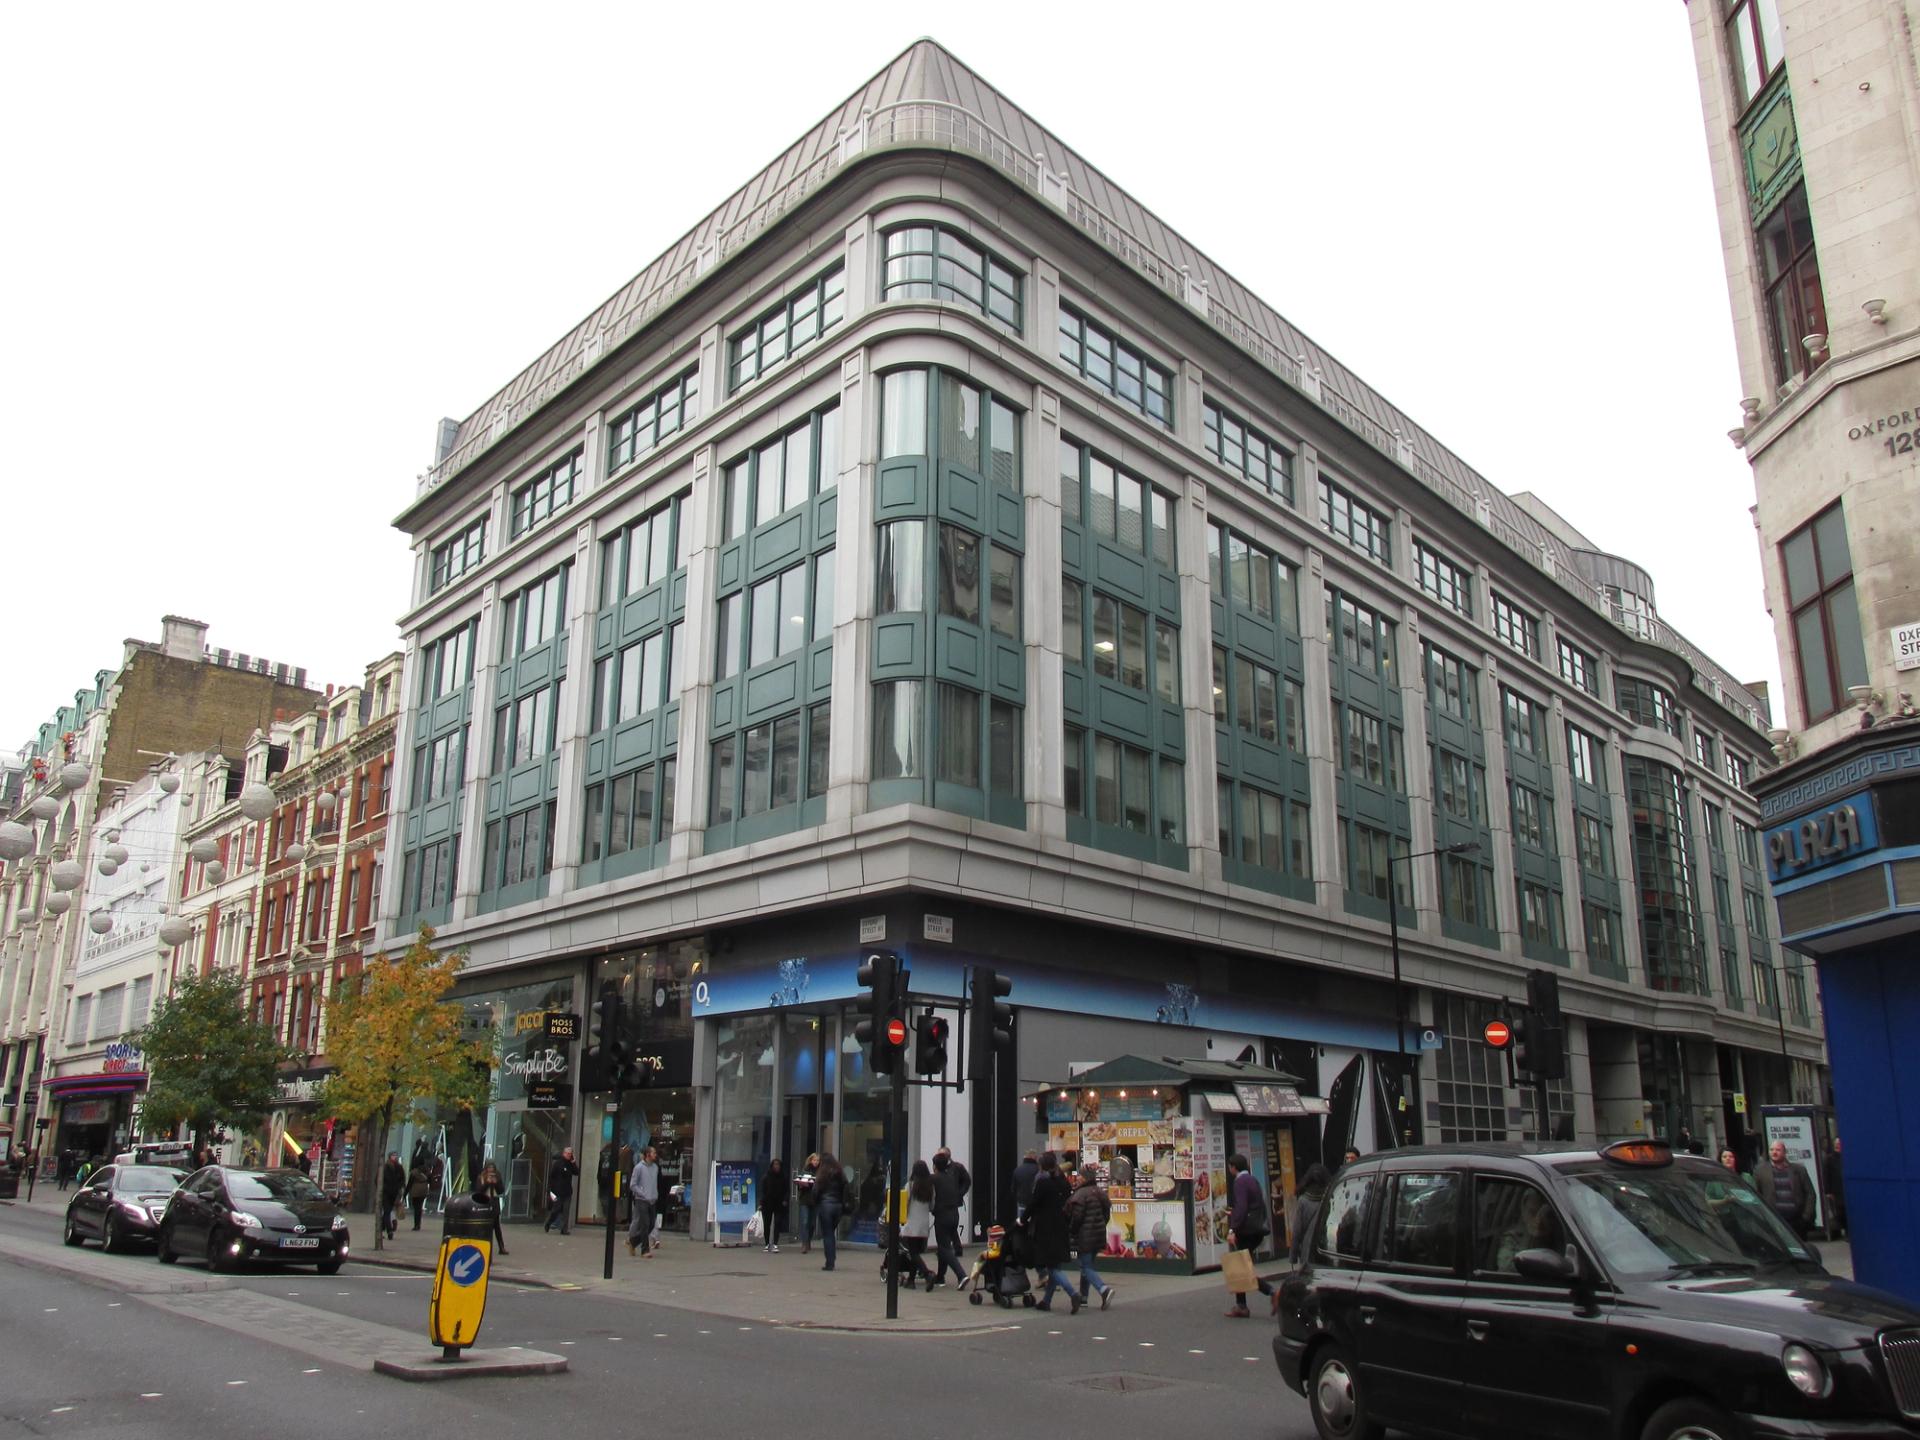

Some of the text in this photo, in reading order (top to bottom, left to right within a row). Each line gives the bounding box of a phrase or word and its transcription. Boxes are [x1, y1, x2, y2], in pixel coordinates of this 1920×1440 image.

[1769, 805, 1860, 874] PLAZA
[927, 924, 944, 933] STREET
[551, 1018, 573, 1027] MOSS
[551, 1026, 575, 1035] BROS.
[662, 1113, 675, 1121] OWN
[662, 1121, 671, 1129] THE
[661, 1129, 676, 1137] NIGHT
